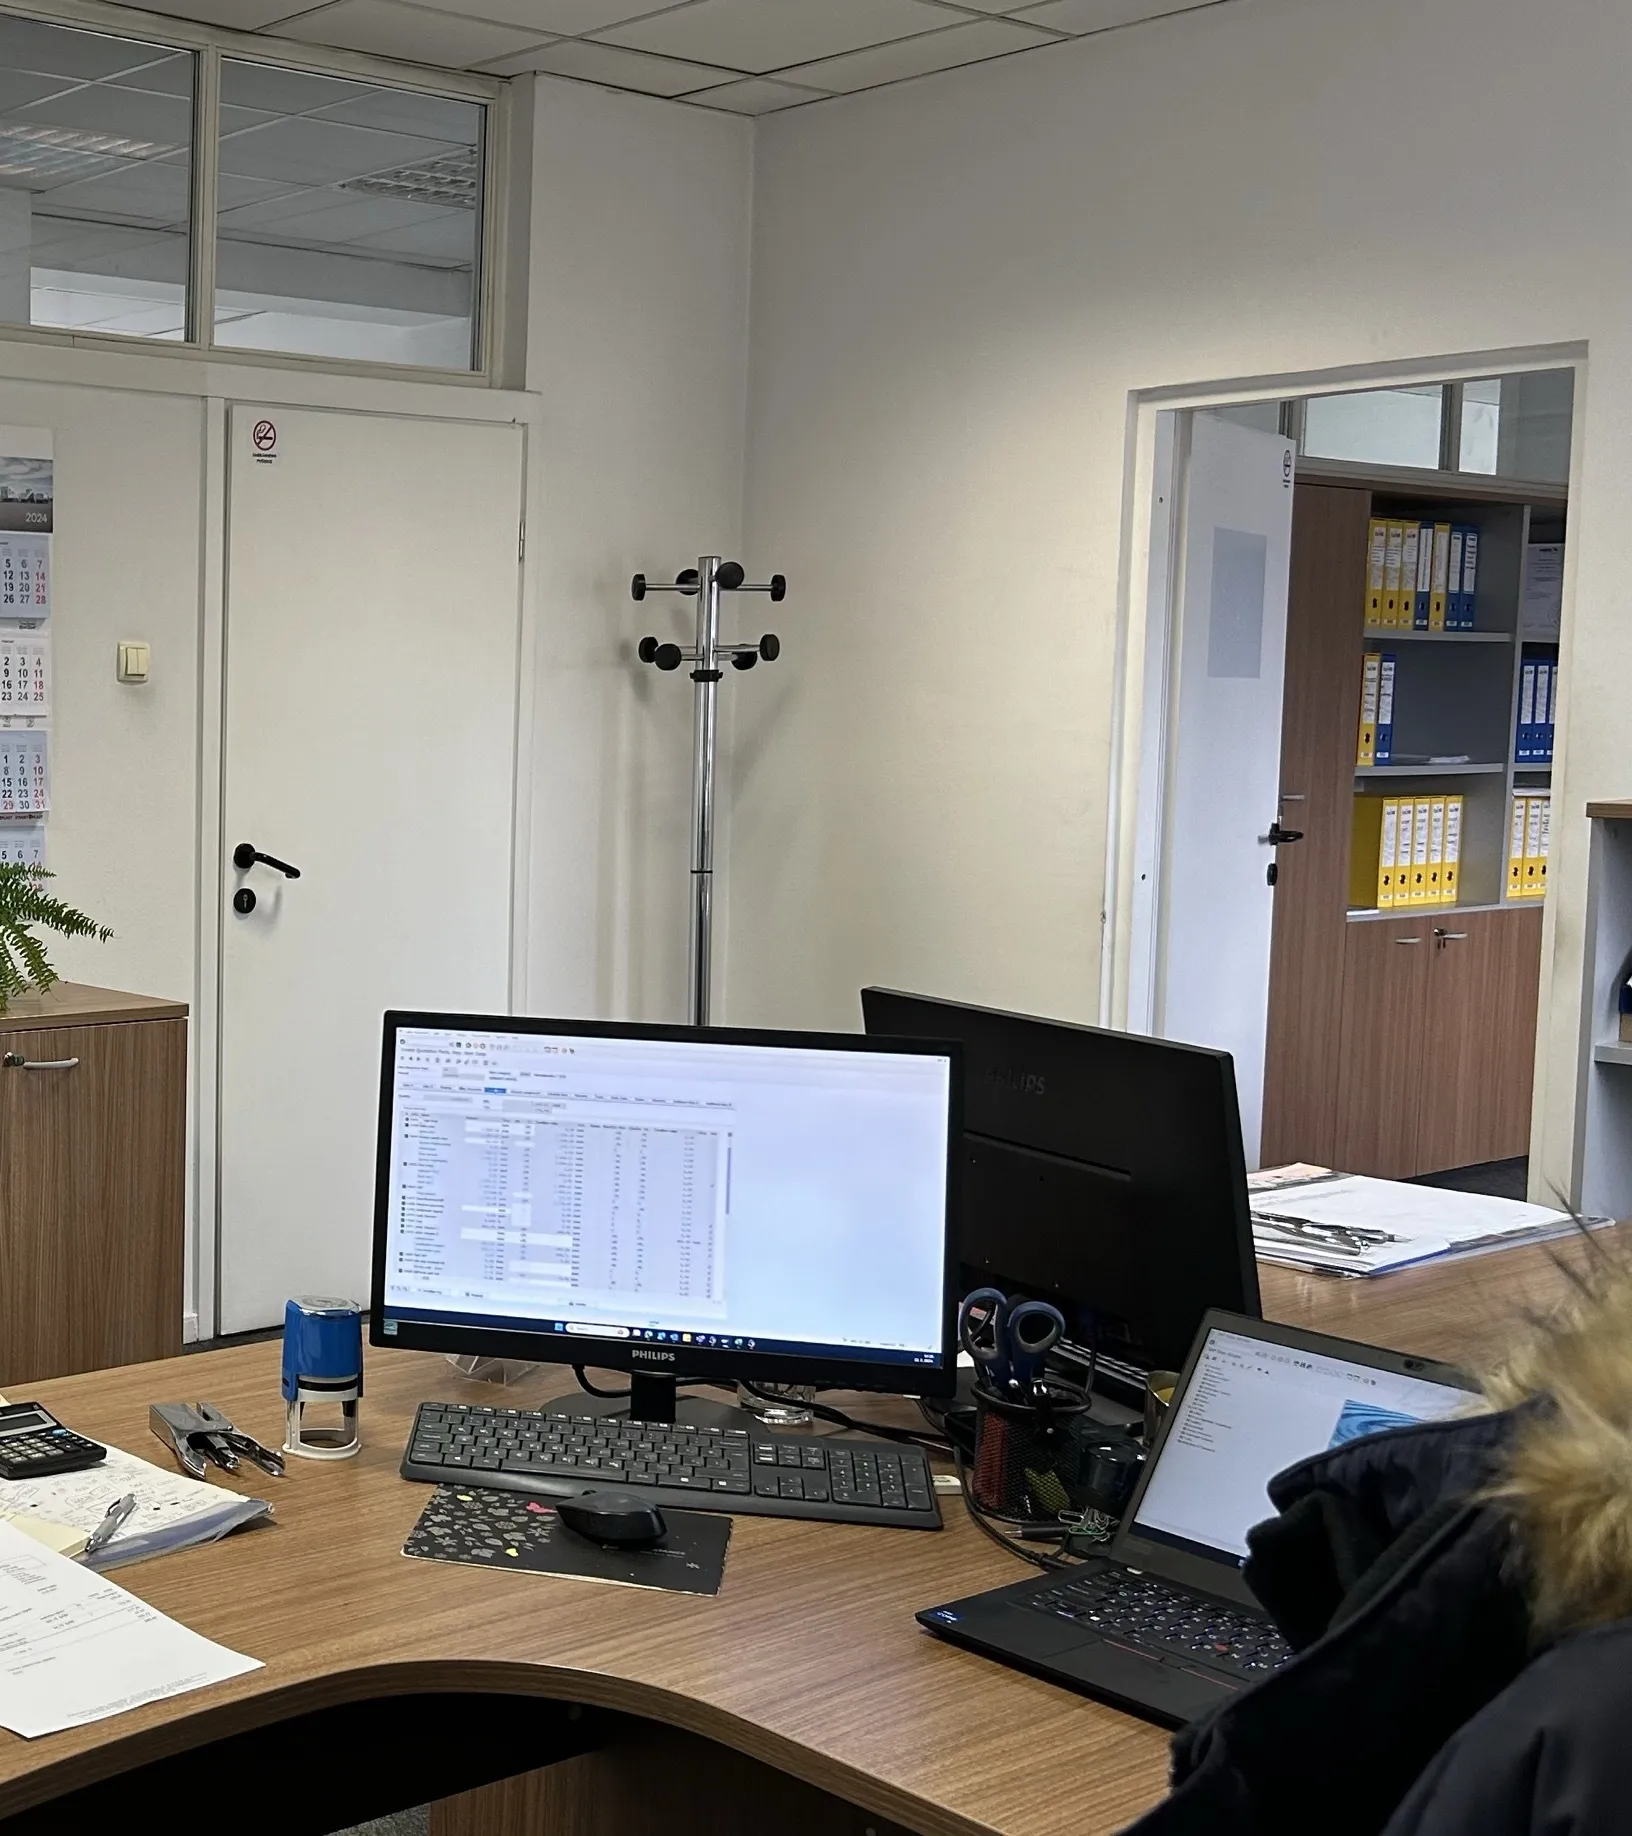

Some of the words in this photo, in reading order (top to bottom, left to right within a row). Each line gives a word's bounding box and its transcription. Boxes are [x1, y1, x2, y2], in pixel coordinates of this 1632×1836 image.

[26, 512, 48, 523] 2024
[6, 559, 10, 568] 5
[21, 559, 27, 568] 6
[37, 560, 42, 569] 7
[4, 570, 13, 580] 12
[20, 571, 29, 580] 13
[36, 572, 45, 581] 14
[4, 582, 14, 591] 19
[20, 583, 30, 592] 20
[36, 584, 45, 592] 21
[4, 594, 14, 603] 26
[20, 594, 30, 604] 27
[36, 595, 46, 604] 28
[4, 656, 9, 666] 2
[20, 657, 25, 666] 3
[36, 658, 41, 666] 4
[4, 668, 9, 677] 9
[18, 669, 28, 678] 10
[34, 669, 42, 678] 11
[2, 680, 12, 689] 16
[18, 680, 28, 689] 17
[34, 680, 44, 690] 18
[2, 692, 12, 700] 23
[18, 692, 28, 700] 24
[34, 692, 44, 701] 25
[4, 755, 8, 764] 1
[20, 754, 24, 764] 2
[36, 754, 40, 764] 3
[4, 766, 9, 775] 8
[20, 766, 24, 775] 9
[34, 766, 43, 775] 10
[2, 778, 12, 787] 15
[18, 778, 28, 786] 16
[34, 778, 44, 786] 17
[2, 789, 12, 798] 22
[18, 789, 28, 798] 23
[34, 789, 44, 798] 24
[3, 800, 14, 810] 29
[19, 801, 29, 809] 30
[35, 799, 45, 809] 31
[2, 851, 6, 860] 5
[18, 850, 23, 858] 6
[34, 850, 38, 858] 7
[632, 1350, 676, 1362] PHILIPS
